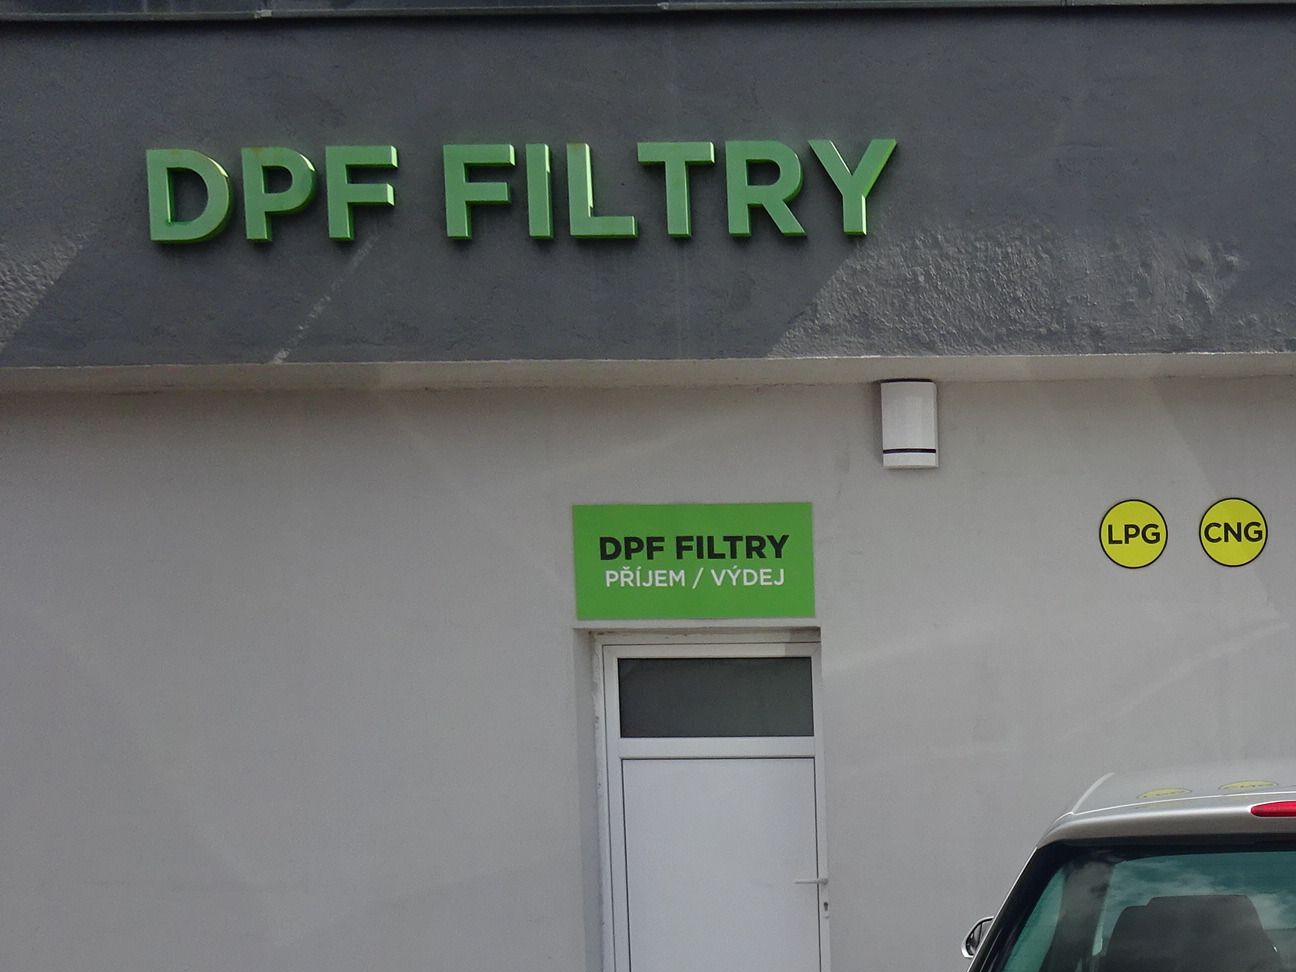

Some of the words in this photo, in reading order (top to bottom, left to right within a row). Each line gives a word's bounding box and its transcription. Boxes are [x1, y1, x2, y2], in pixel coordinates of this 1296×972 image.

[146, 145, 398, 243] DPF
[443, 138, 896, 239] FILTRY
[1107, 524, 1161, 544] LPG
[1204, 522, 1263, 543] CNG
[599, 536, 665, 560] DPF
[675, 534, 789, 559] FILTRY
[605, 566, 686, 587] PŘÍJEM
[692, 568, 704, 589] /
[711, 565, 785, 586] VÝDEJ
